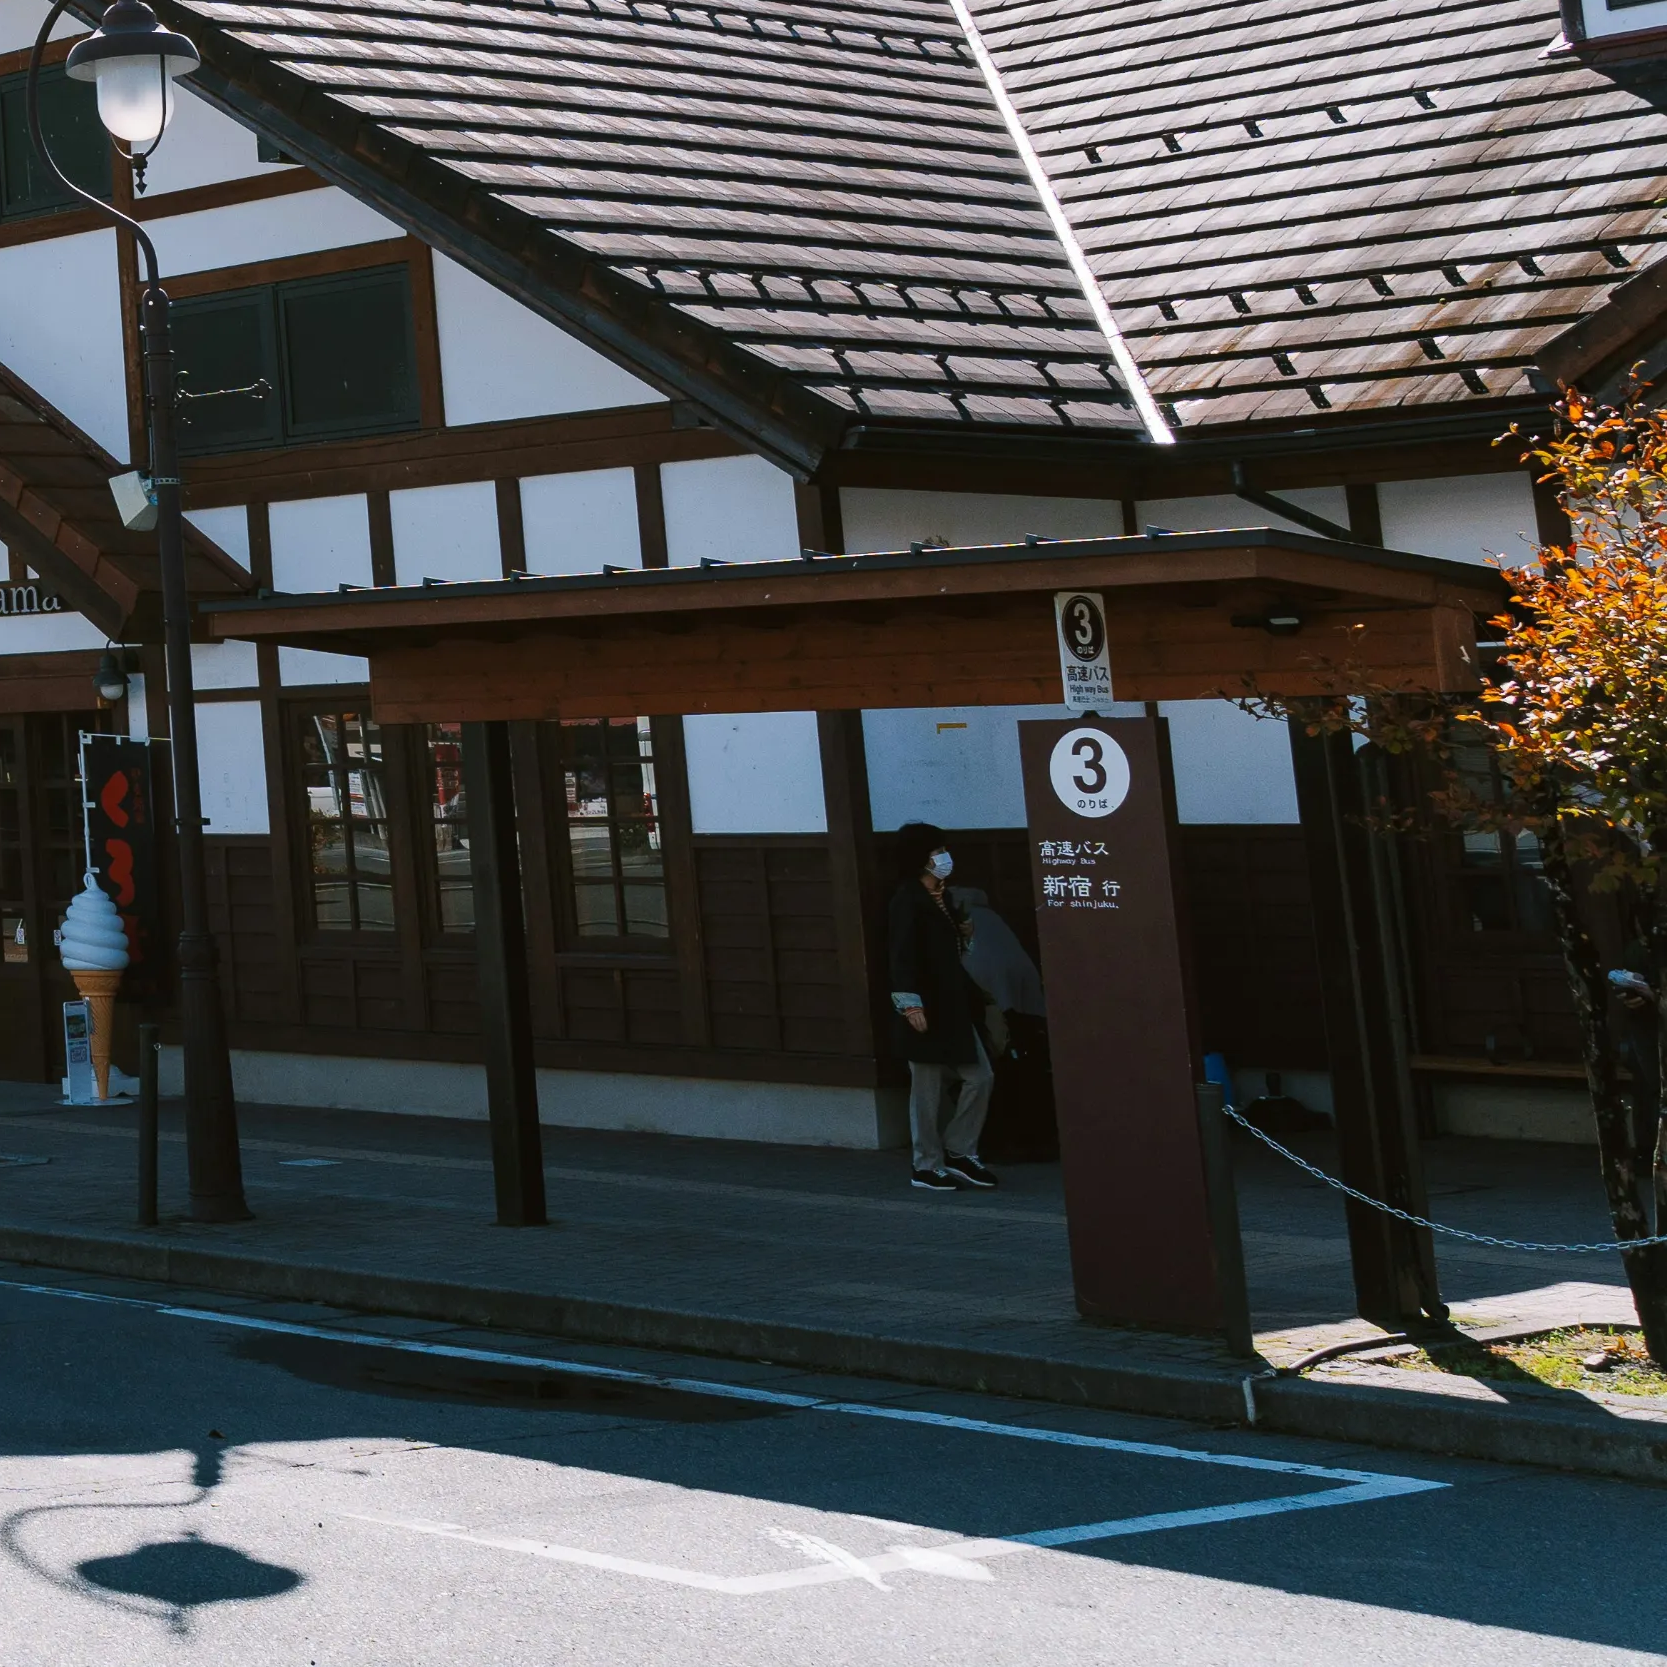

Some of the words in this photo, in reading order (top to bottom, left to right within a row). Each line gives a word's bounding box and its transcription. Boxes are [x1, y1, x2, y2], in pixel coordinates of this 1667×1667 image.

[1073, 602, 1093, 645] 3
[1066, 665, 1110, 682] 高速バス
[1097, 684, 1109, 694] Bus
[1071, 736, 1107, 795] 3
[1038, 840, 1109, 857] 高速バス
[1042, 857, 1076, 866] Highway
[1080, 857, 1096, 865] Bus
[1043, 874, 1092, 898] 新宿
[1102, 879, 1121, 897] 行
[1047, 899, 1064, 907] For
[1070, 899, 1119, 909] shinjuku.
